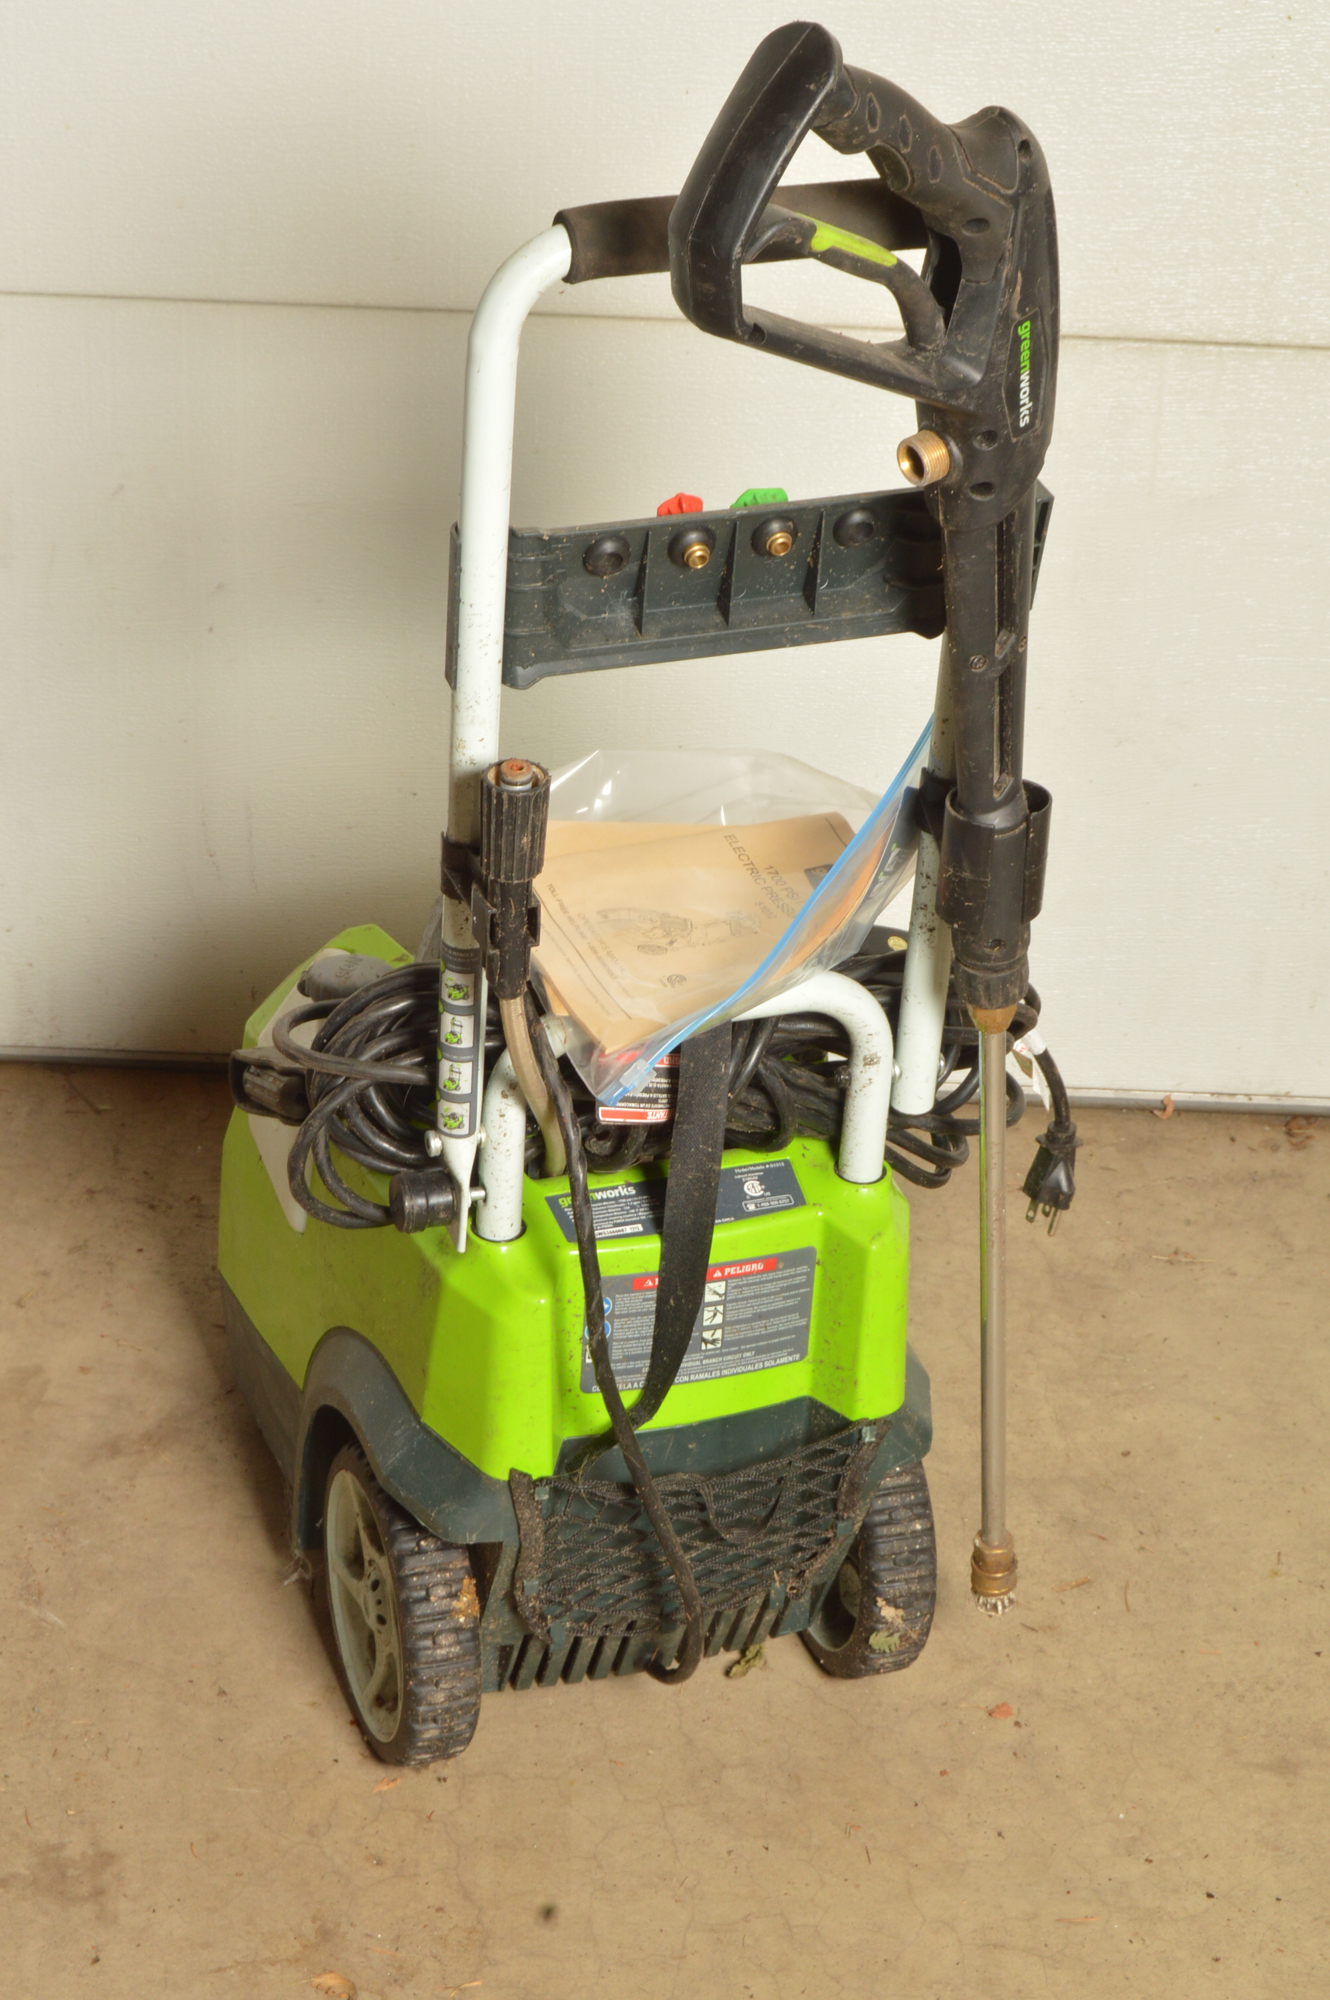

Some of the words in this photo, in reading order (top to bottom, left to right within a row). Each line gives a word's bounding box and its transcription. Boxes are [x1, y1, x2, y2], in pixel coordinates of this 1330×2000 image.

[1017, 320, 1033, 428] greenworks
[724, 834, 767, 885] ELECTRIC
[760, 886, 798, 918] PRESSU
[764, 865, 787, 886] 1700
[558, 1185, 636, 1208] grnworks
[724, 1262, 764, 1276] PELIGRO
[690, 1370, 720, 1381] RAMALES
[721, 1362, 763, 1376] INDIVIDUALES
[764, 1353, 801, 1367] SOLAMENTE
